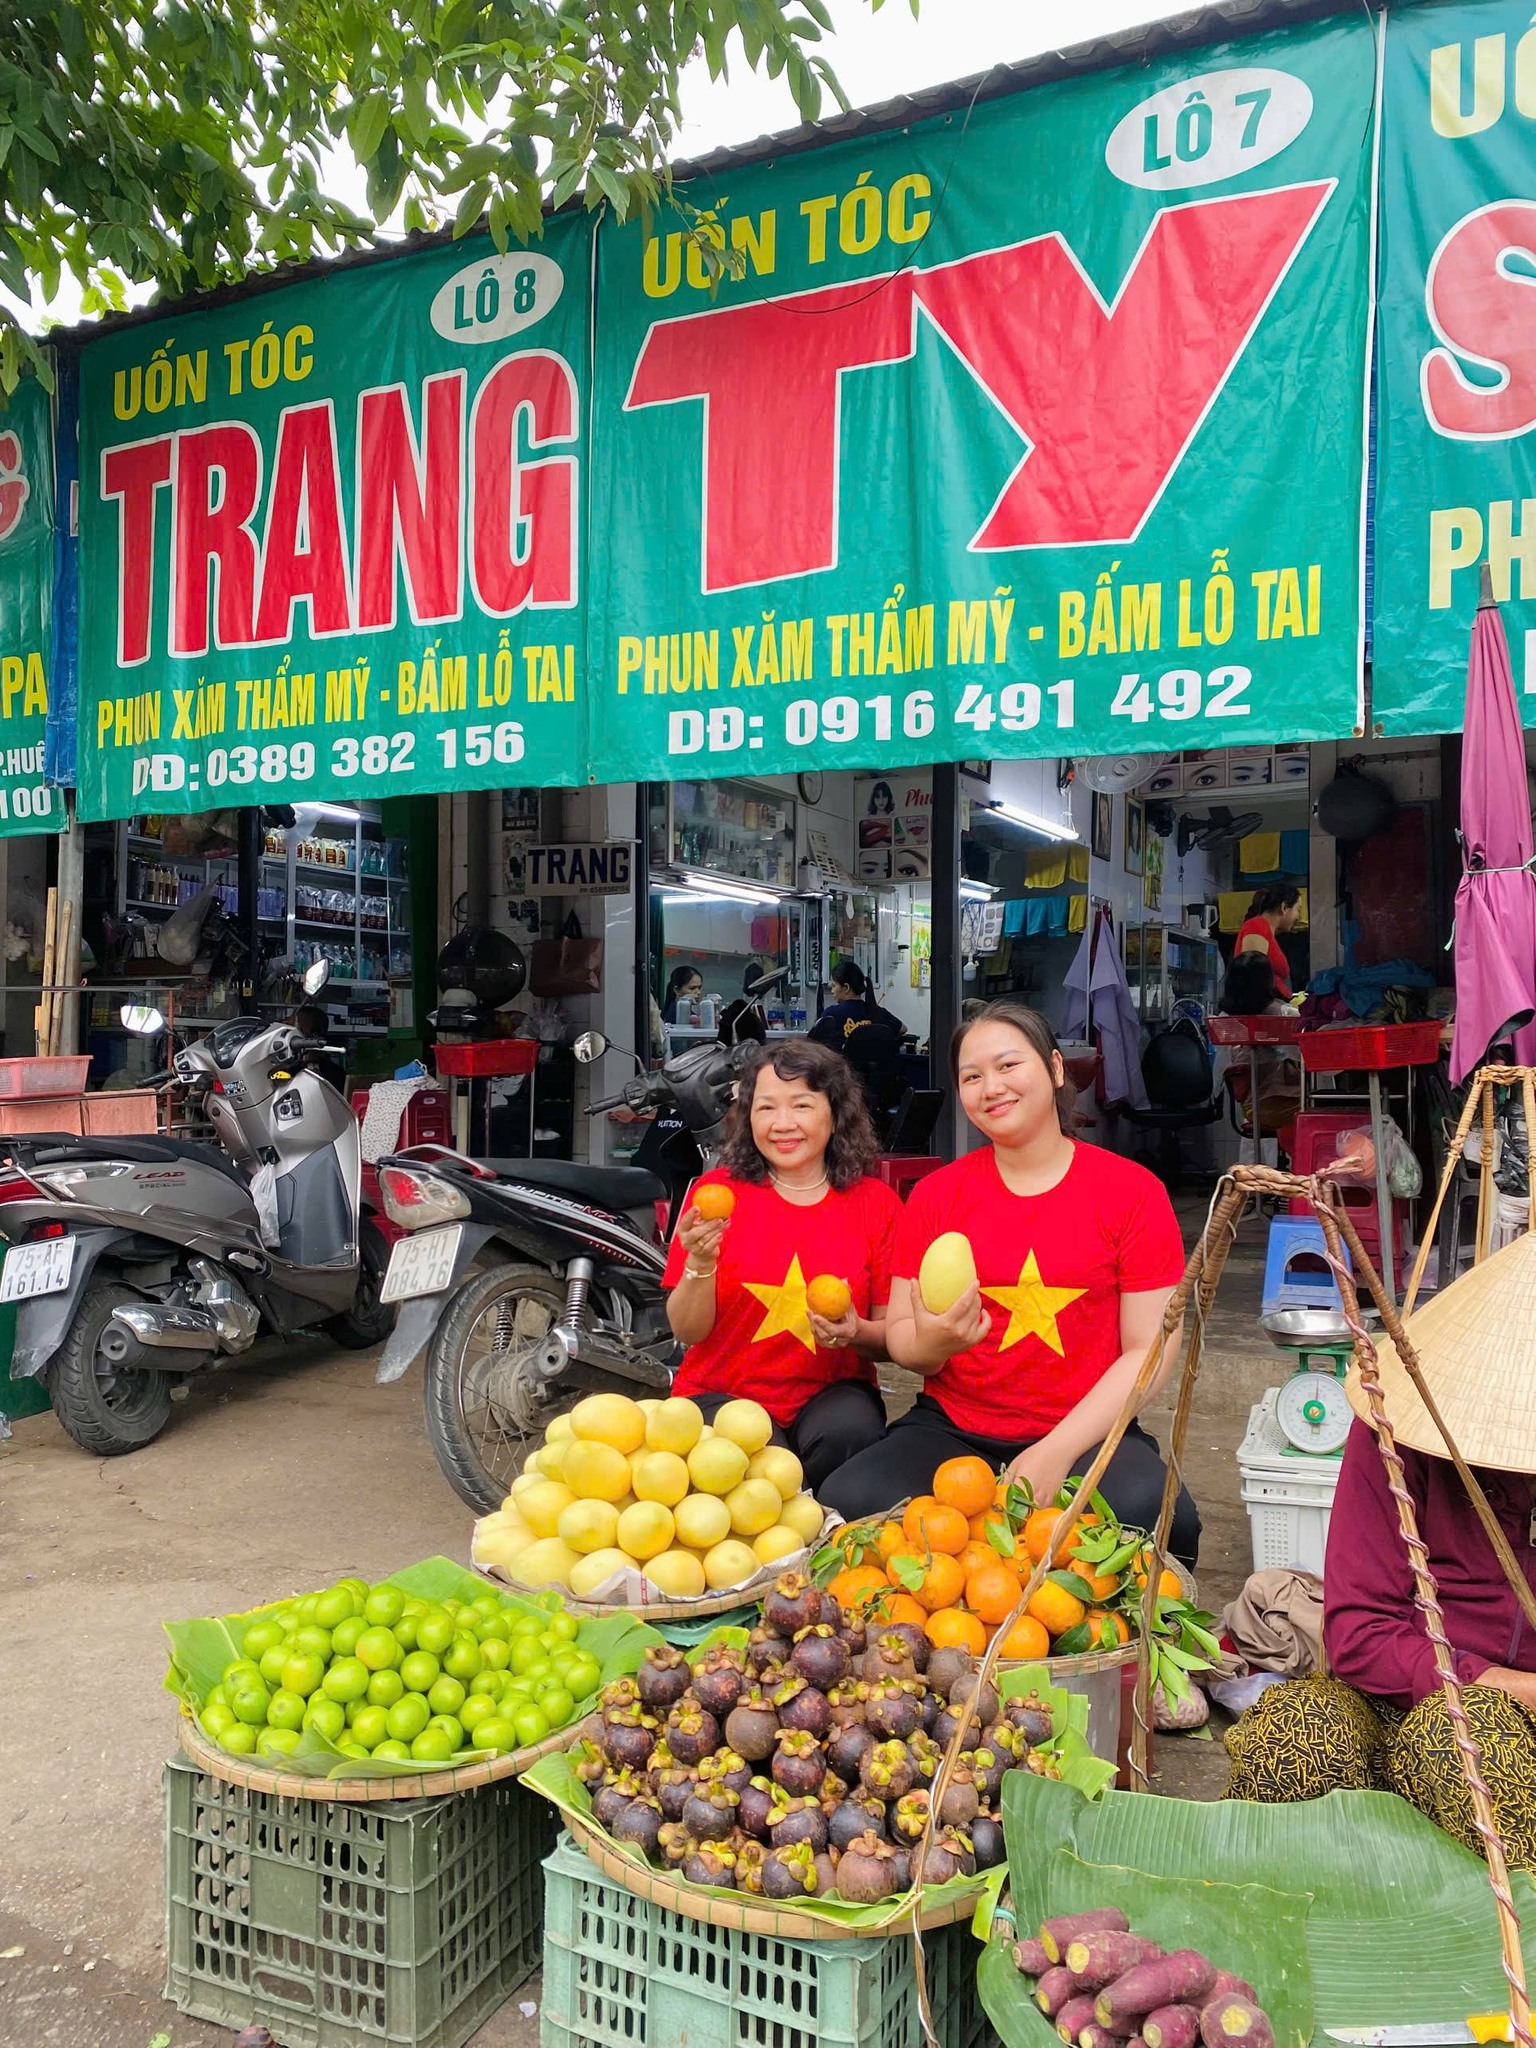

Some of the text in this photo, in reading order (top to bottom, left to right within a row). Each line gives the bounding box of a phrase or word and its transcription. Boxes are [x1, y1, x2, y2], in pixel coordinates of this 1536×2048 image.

[1142, 87, 1272, 173] LÔ 7
[643, 170, 932, 298] UỐN TÓC
[454, 267, 536, 330] LÔ 8
[113, 321, 314, 420] UỐN TÓC
[622, 177, 1339, 596] TY
[101, 348, 579, 668] TRANG
[617, 630, 719, 695] PHUN
[731, 609, 813, 688] XĂM
[826, 583, 934, 677] THẨM
[947, 585, 1015, 666] MỸ
[1058, 560, 1162, 659] BẤM
[1177, 547, 1234, 648] LỖ
[1251, 564, 1321, 641] TAI
[97, 690, 161, 749] PHUN
[171, 676, 226, 739] XĂM
[235, 655, 315, 731] THẨM
[325, 656, 370, 724] MỸ
[397, 640, 466, 715] BẤM
[478, 628, 514, 706] LỖ
[522, 645, 575, 703] TAI
[668, 665, 1253, 755] DĐ: 0916 491 492
[331, 731, 416, 776] 382
[436, 721, 525, 769] 156
[527, 847, 629, 885] TRANG
[132, 1171, 185, 1180] LEAD
[6, 1265, 64, 1297] 161.14
